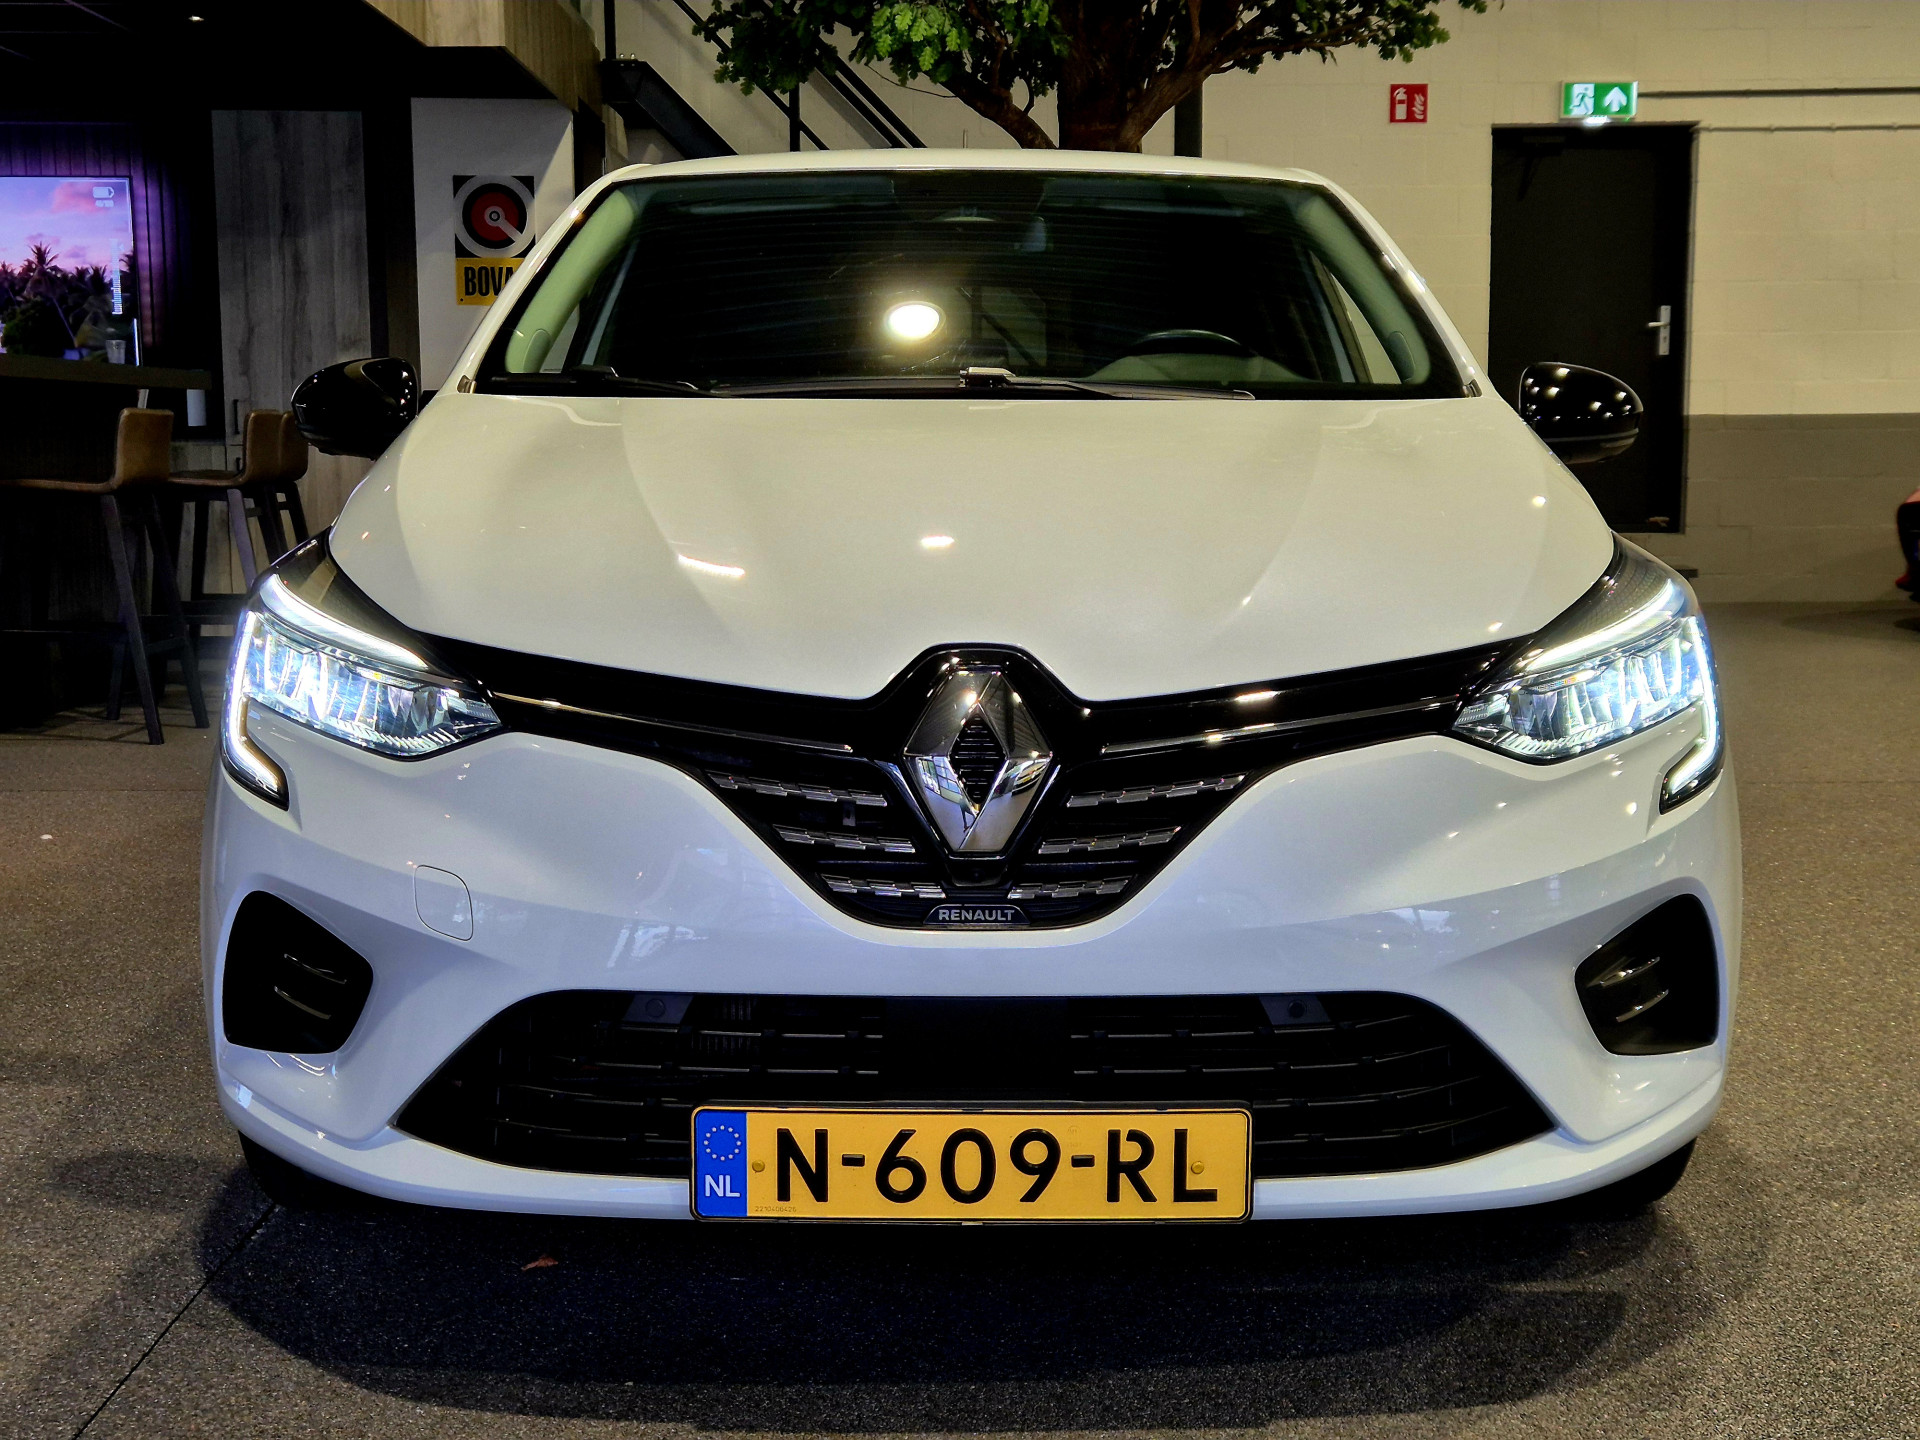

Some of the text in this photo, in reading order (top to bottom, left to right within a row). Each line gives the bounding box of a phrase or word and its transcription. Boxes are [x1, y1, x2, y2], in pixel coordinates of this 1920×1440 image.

[938, 909, 1015, 921] RENAULT
[776, 1127, 1218, 1204] N-609-RL
[704, 1174, 741, 1198] NL
